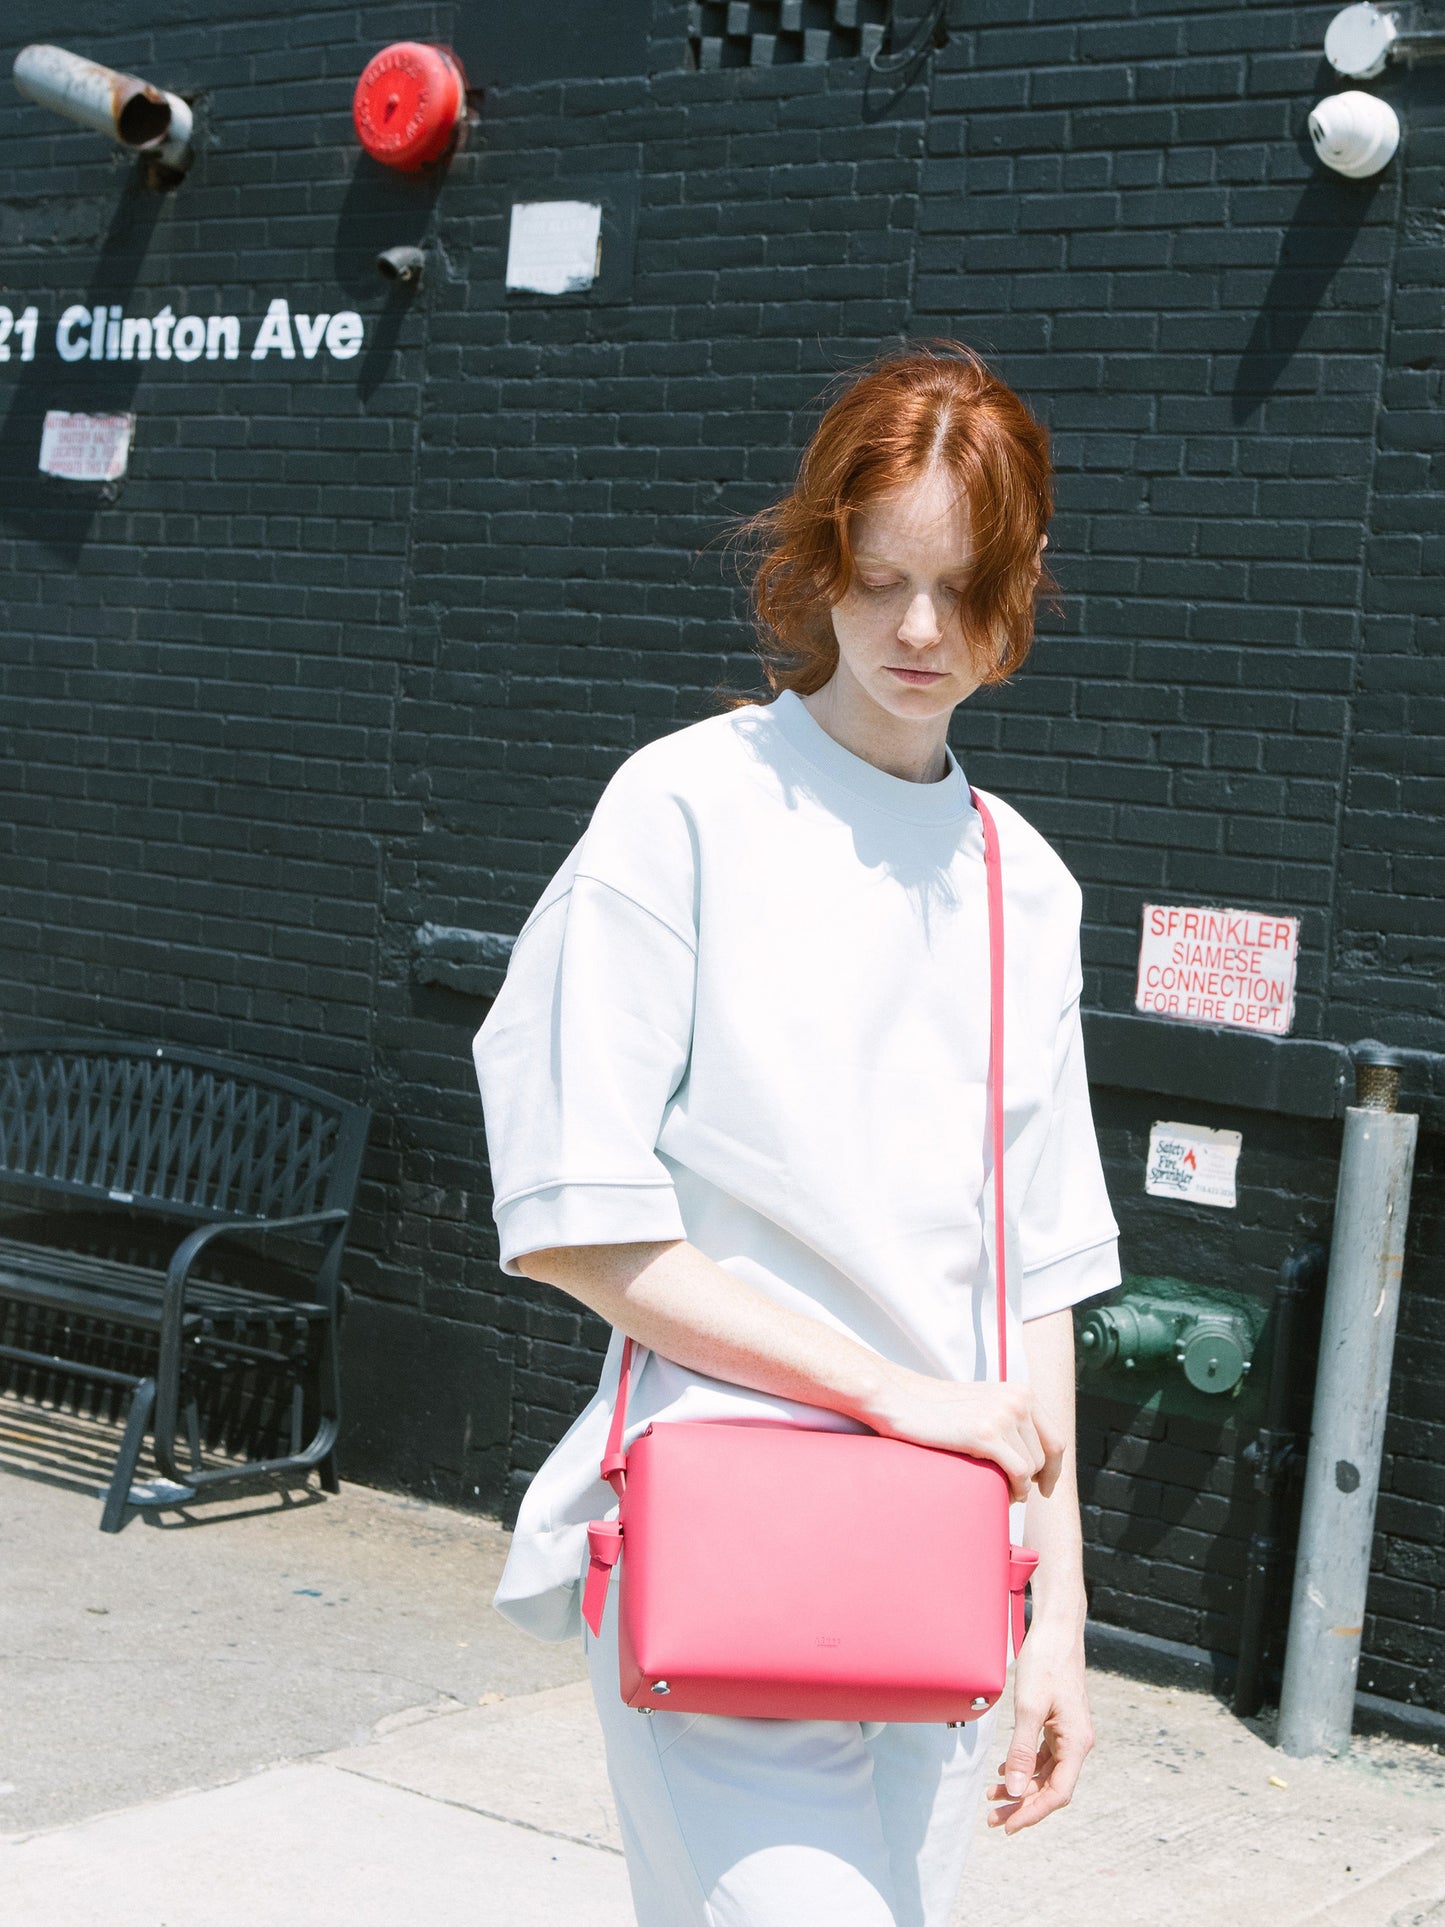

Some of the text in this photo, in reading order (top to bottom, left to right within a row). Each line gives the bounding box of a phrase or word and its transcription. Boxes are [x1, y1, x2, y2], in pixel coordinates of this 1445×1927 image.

[55, 304, 241, 362] Clinton
[251, 298, 365, 360] Ave
[1171, 941, 1264, 975] SIAMESE
[1146, 965, 1285, 1004] CONNECTION
[1143, 991, 1282, 1028] FOR FIRE DEPT.
[1156, 1139, 1187, 1160] Safety
[1158, 1154, 1178, 1170] Fire
[1149, 1167, 1194, 1185] Sprinkler
